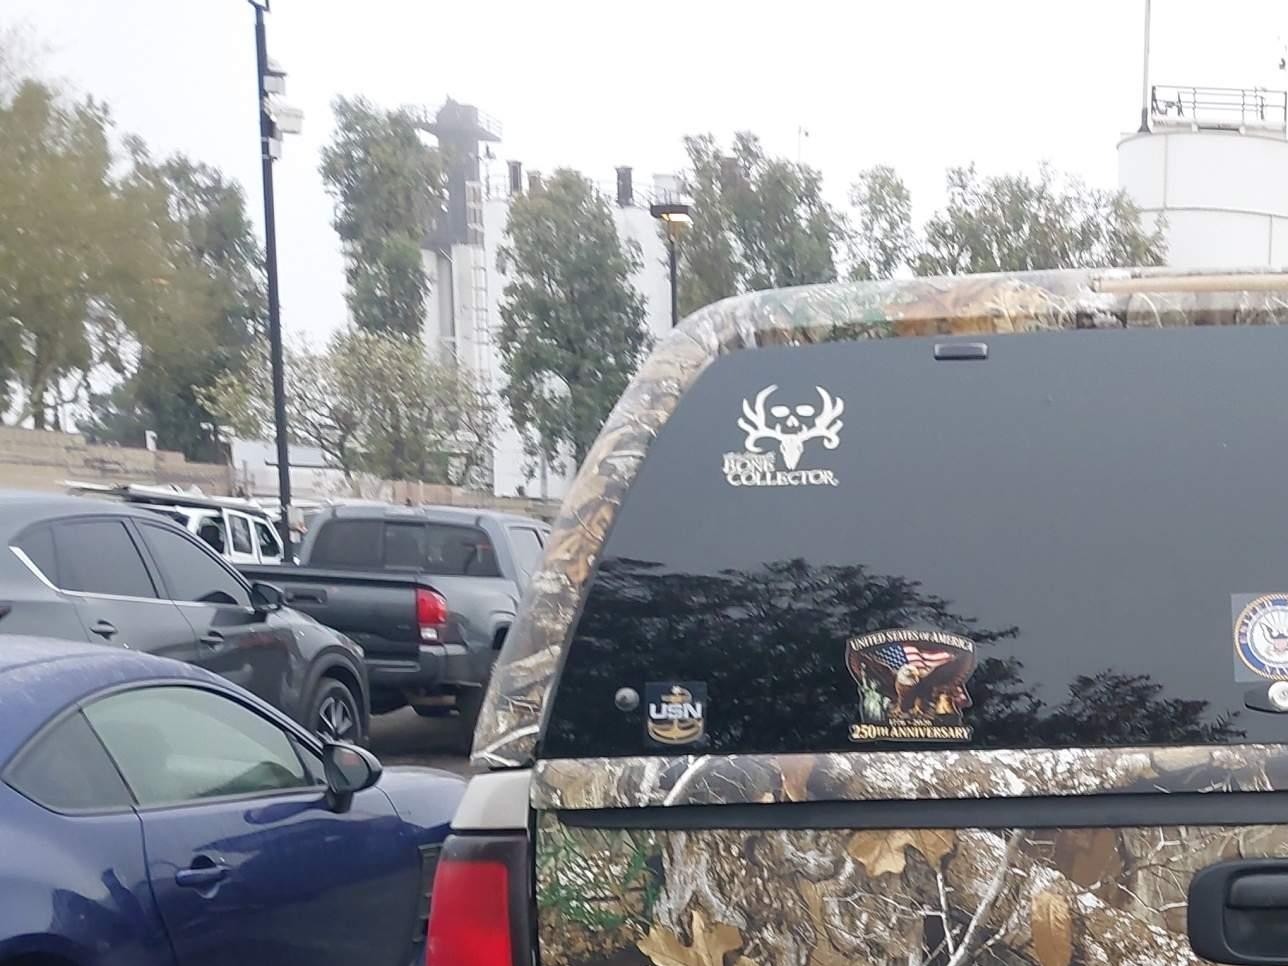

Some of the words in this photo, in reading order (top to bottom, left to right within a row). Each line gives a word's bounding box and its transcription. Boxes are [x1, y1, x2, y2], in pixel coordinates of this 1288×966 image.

[722, 451, 776, 474] BONE
[726, 469, 836, 487] COLLECTOR
[849, 632, 886, 651] UNITED
[886, 630, 919, 641] STATES
[930, 631, 974, 653] AMERICA
[648, 701, 703, 720] USN
[890, 726, 970, 739] ANNIVERSARY
